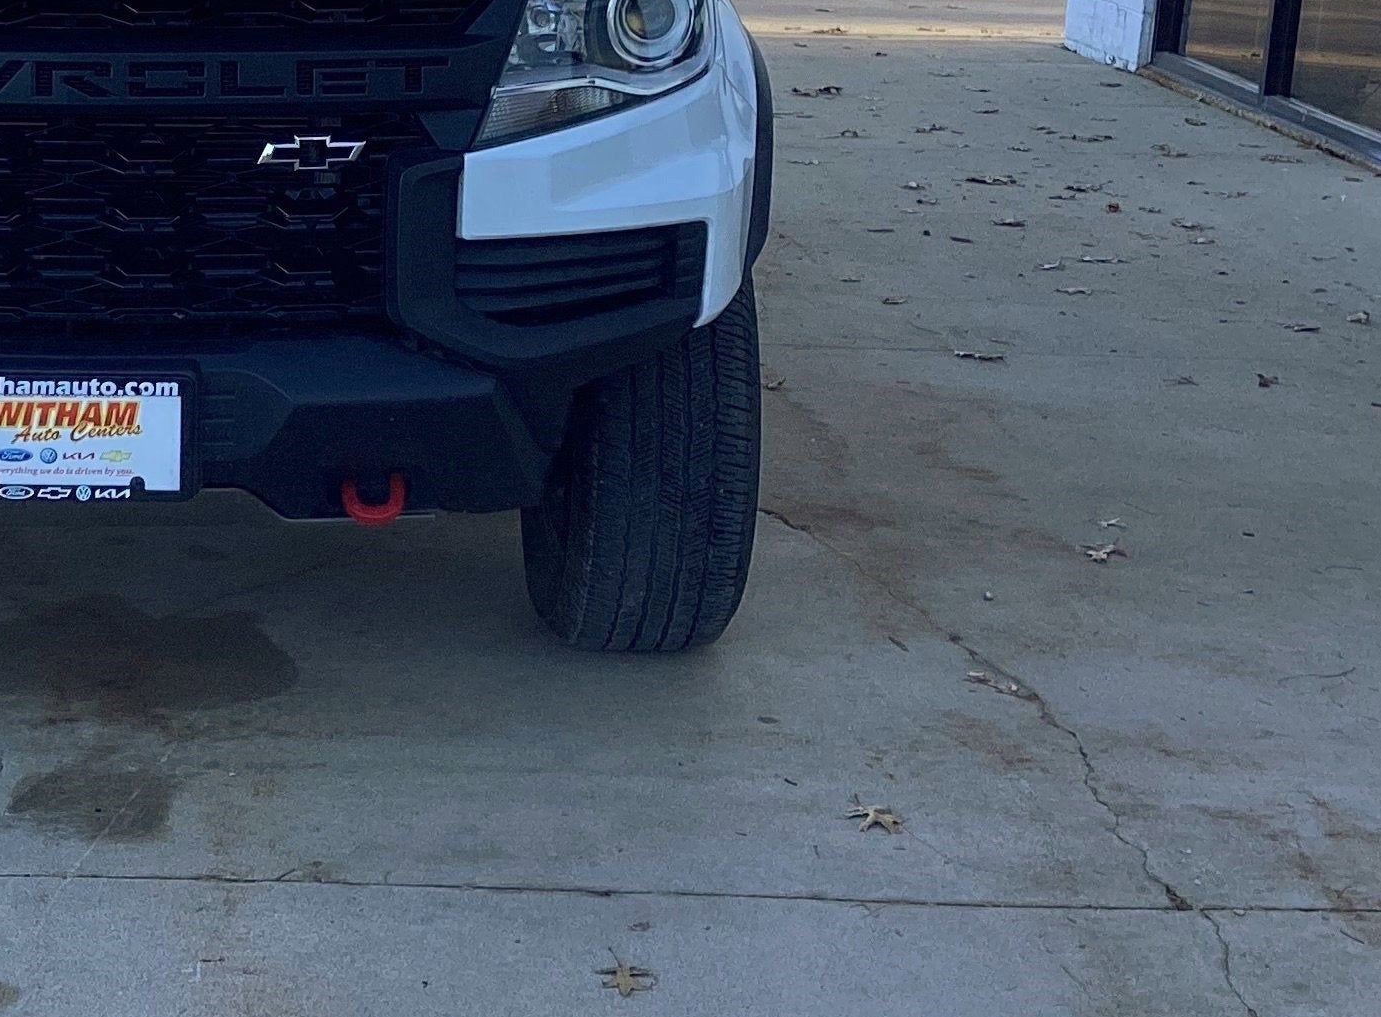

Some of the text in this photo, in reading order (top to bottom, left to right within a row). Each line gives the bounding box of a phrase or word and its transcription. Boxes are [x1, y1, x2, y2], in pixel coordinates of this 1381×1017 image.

[10, 422, 142, 444] Auto Centers
[53, 466, 65, 474] do
[74, 467, 102, 475] driven
[104, 467, 115, 476] by
